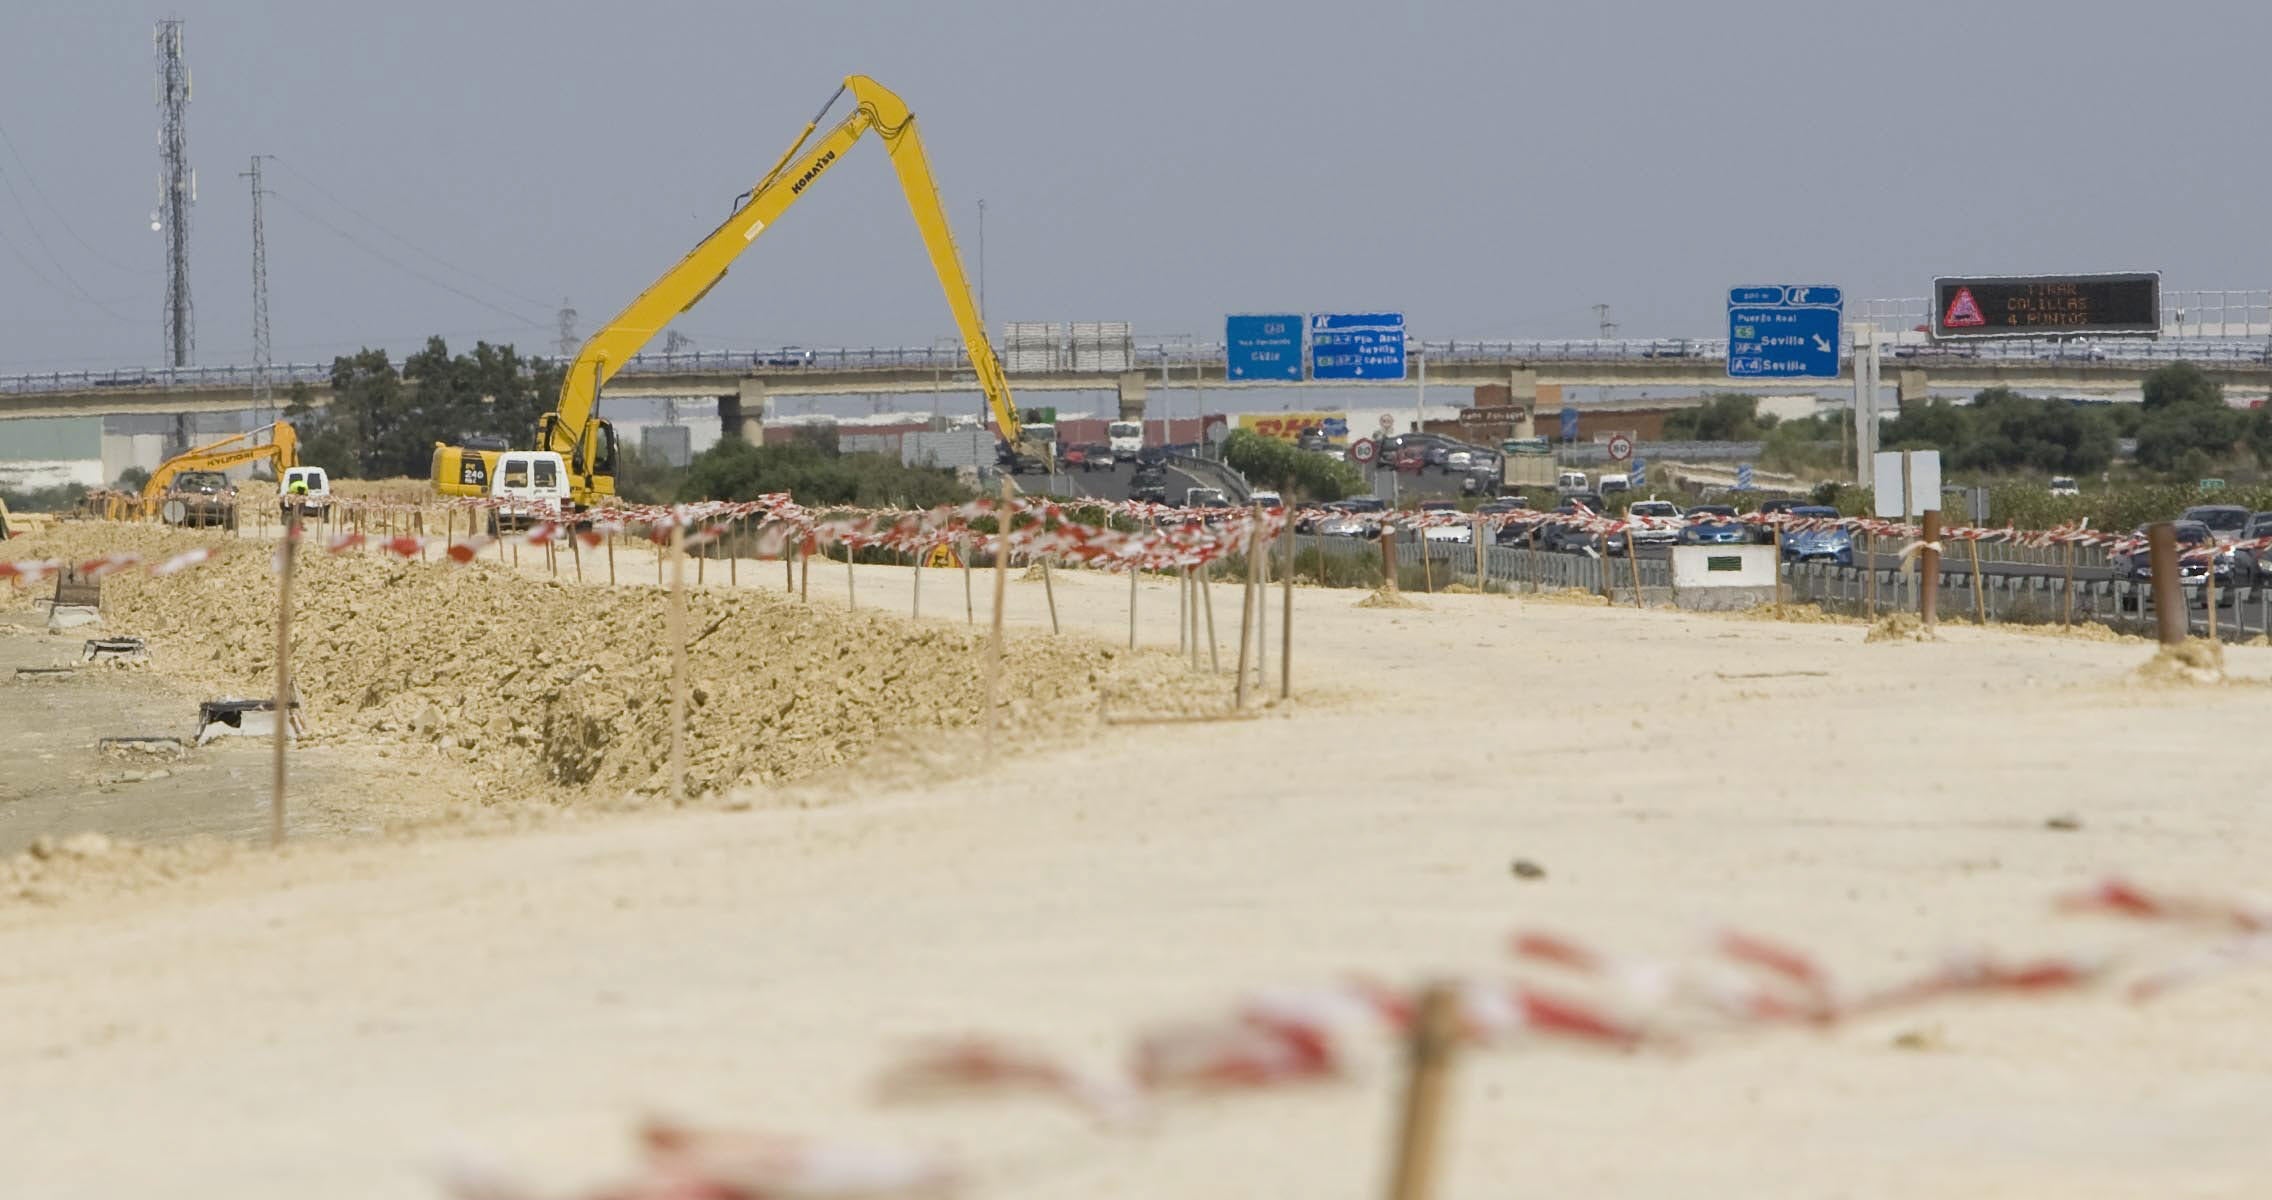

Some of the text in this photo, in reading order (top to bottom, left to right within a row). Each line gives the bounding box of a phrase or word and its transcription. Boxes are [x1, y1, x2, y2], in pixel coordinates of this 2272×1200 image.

[791, 150, 836, 195] KOMATSU
[1761, 335, 1805, 346] Sevilla
[1763, 359, 1807, 371] Sevilla
[207, 450, 254, 466] HYUNDAI
[464, 469, 484, 480] 240
